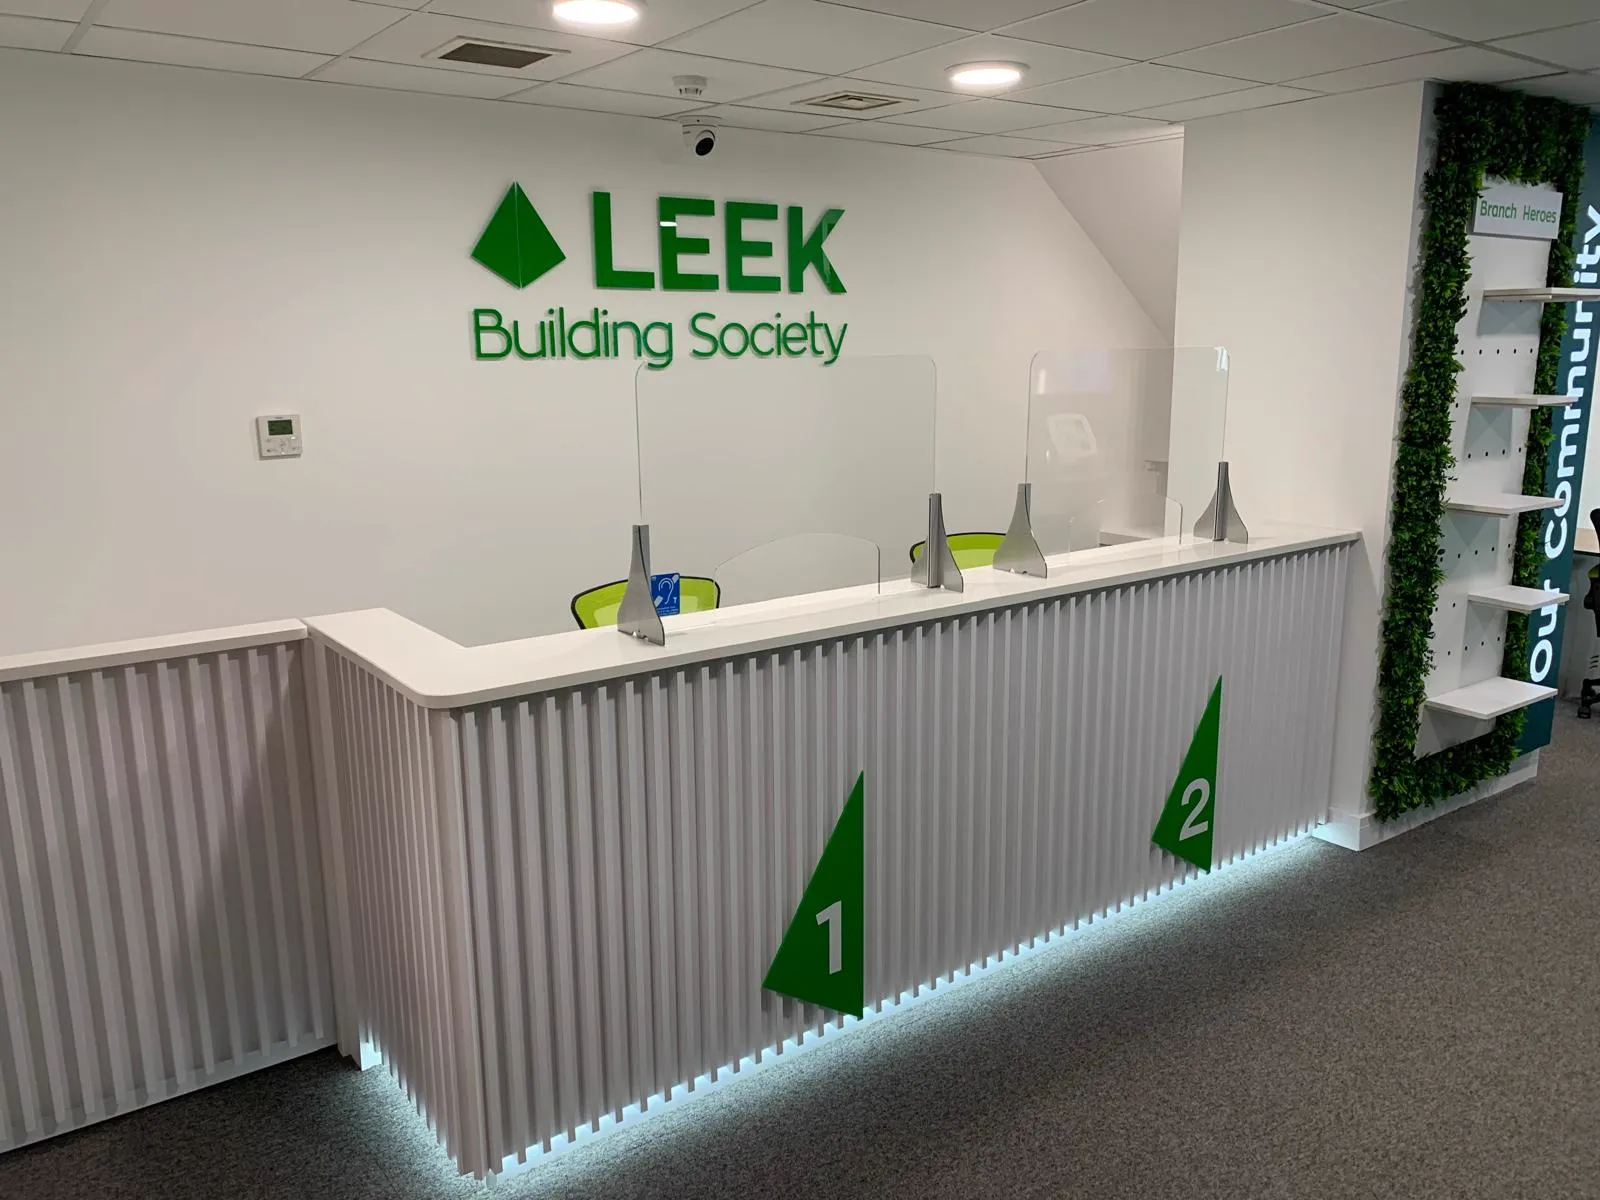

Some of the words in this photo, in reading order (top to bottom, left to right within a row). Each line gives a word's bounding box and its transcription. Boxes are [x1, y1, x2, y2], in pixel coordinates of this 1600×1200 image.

[592, 190, 848, 294] LEEK
[1480, 199, 1518, 219] Branch
[1523, 204, 1558, 224] Heroes
[473, 306, 674, 370] Building
[689, 310, 848, 366] Society
[1529, 579, 1560, 683] Our
[1178, 777, 1211, 842] 2
[815, 900, 842, 975] 1
